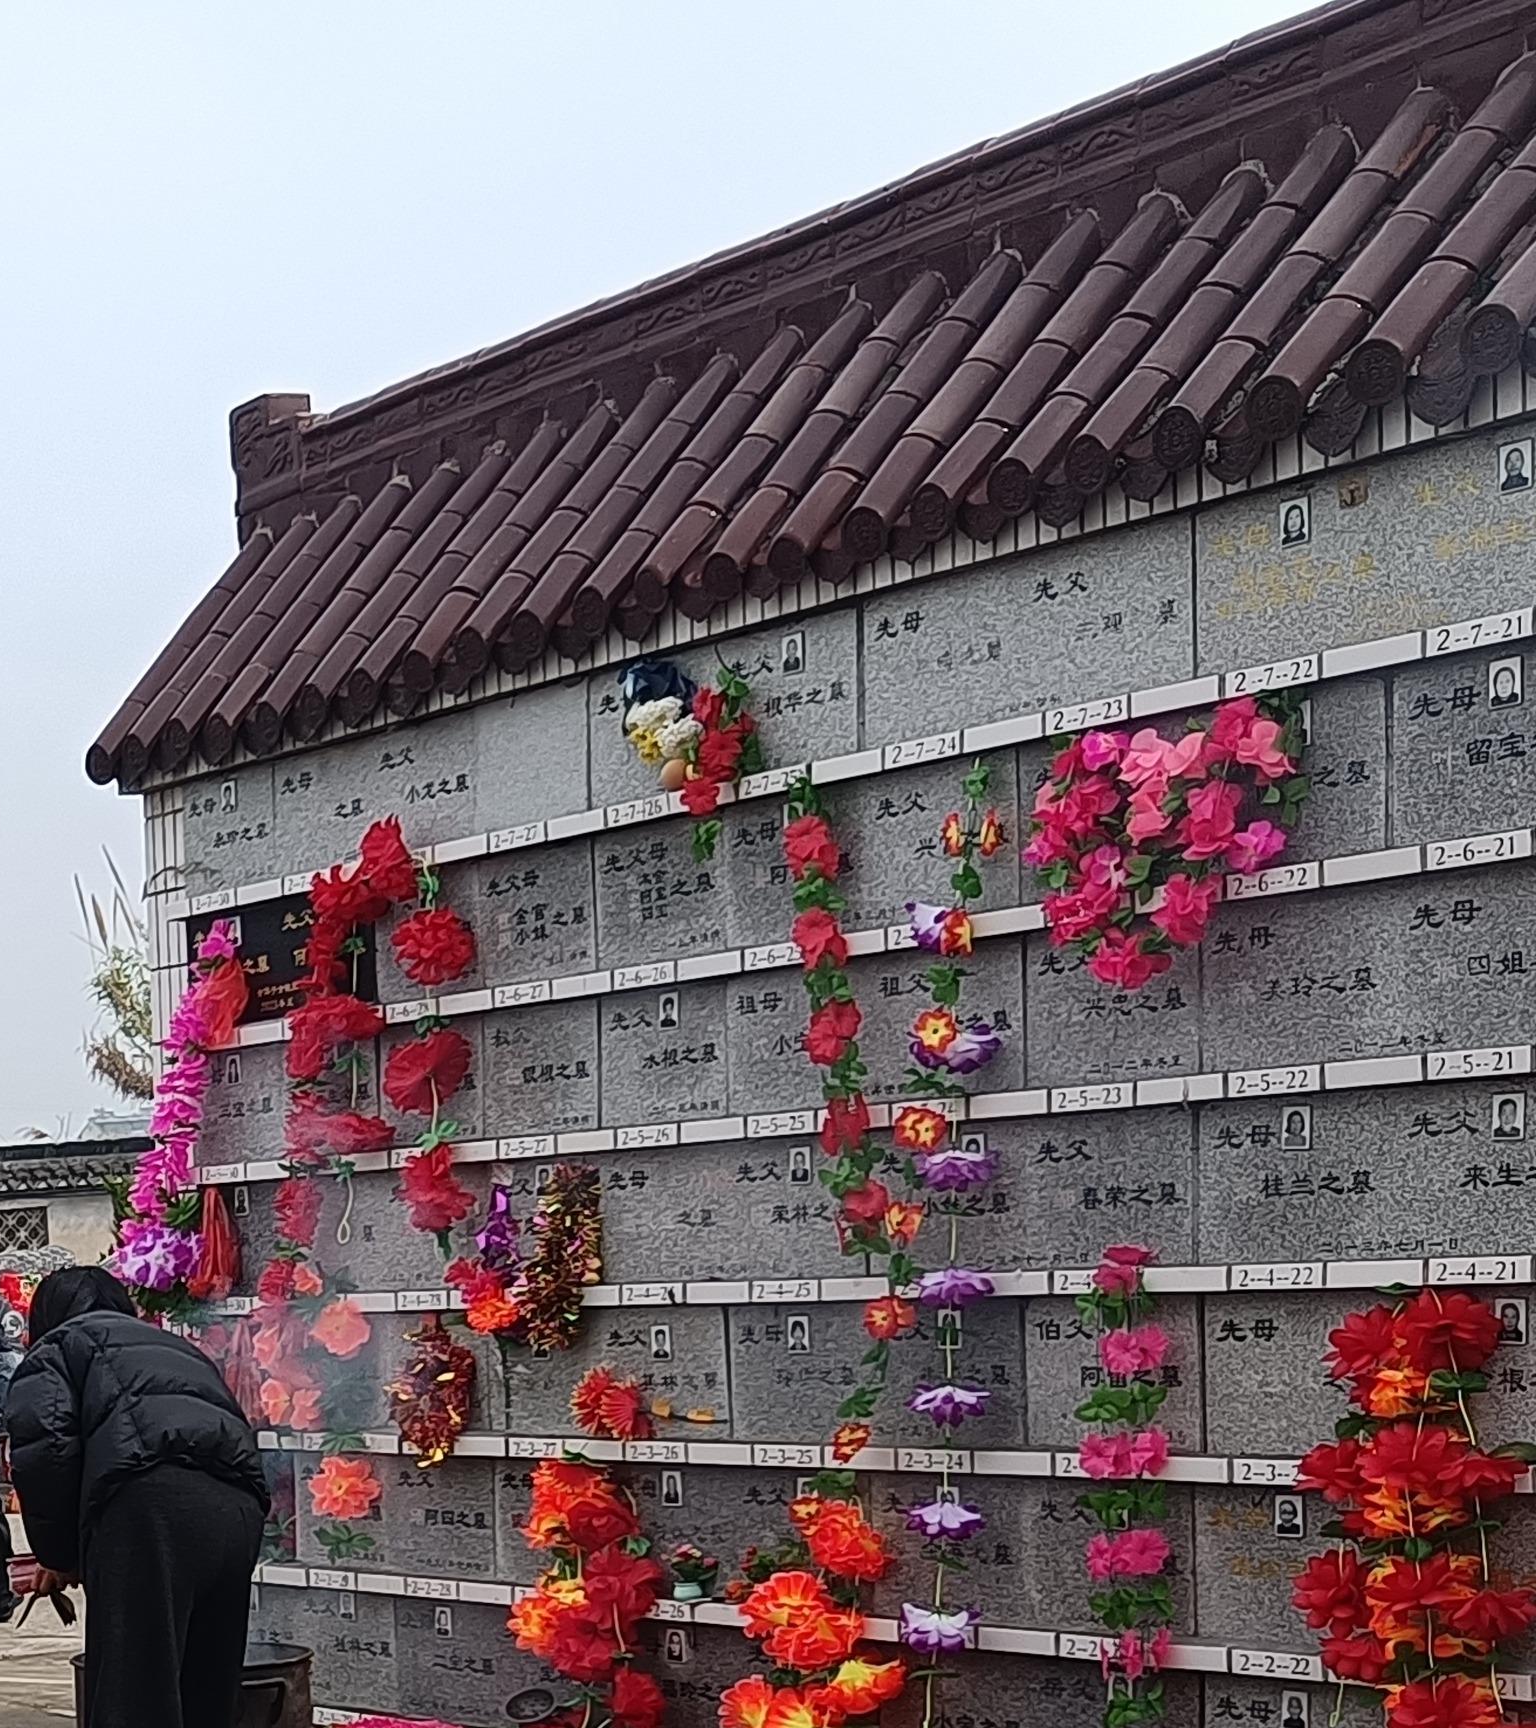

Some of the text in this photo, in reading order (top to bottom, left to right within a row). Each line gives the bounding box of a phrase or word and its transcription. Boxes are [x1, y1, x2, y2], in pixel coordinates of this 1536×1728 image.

[1033, 571, 1088, 603] 先父
[874, 610, 926, 642] 先母
[731, 654, 774, 682] 先父
[1408, 685, 1482, 721] 先母
[378, 745, 415, 771] 先父
[281, 773, 314, 796] 先母
[874, 793, 929, 821] 先父
[732, 821, 780, 849] 先母
[1409, 900, 1483, 932] 先母
[1210, 925, 1276, 956] 先母
[879, 973, 931, 998] 祖父
[734, 992, 785, 1017] 祖母
[608, 1008, 654, 1033] 先父
[1213, 1124, 1277, 1150] 先母
[1408, 1110, 1480, 1140] 先父
[1035, 1139, 1093, 1164] 先父
[607, 1169, 649, 1192] 先母
[736, 1160, 784, 1185] 先父
[607, 1329, 648, 1349] 先父
[1034, 1318, 1094, 1341] 伯父
[1216, 1318, 1280, 1342] 先母
[1212, 1697, 1281, 1724] 先母
